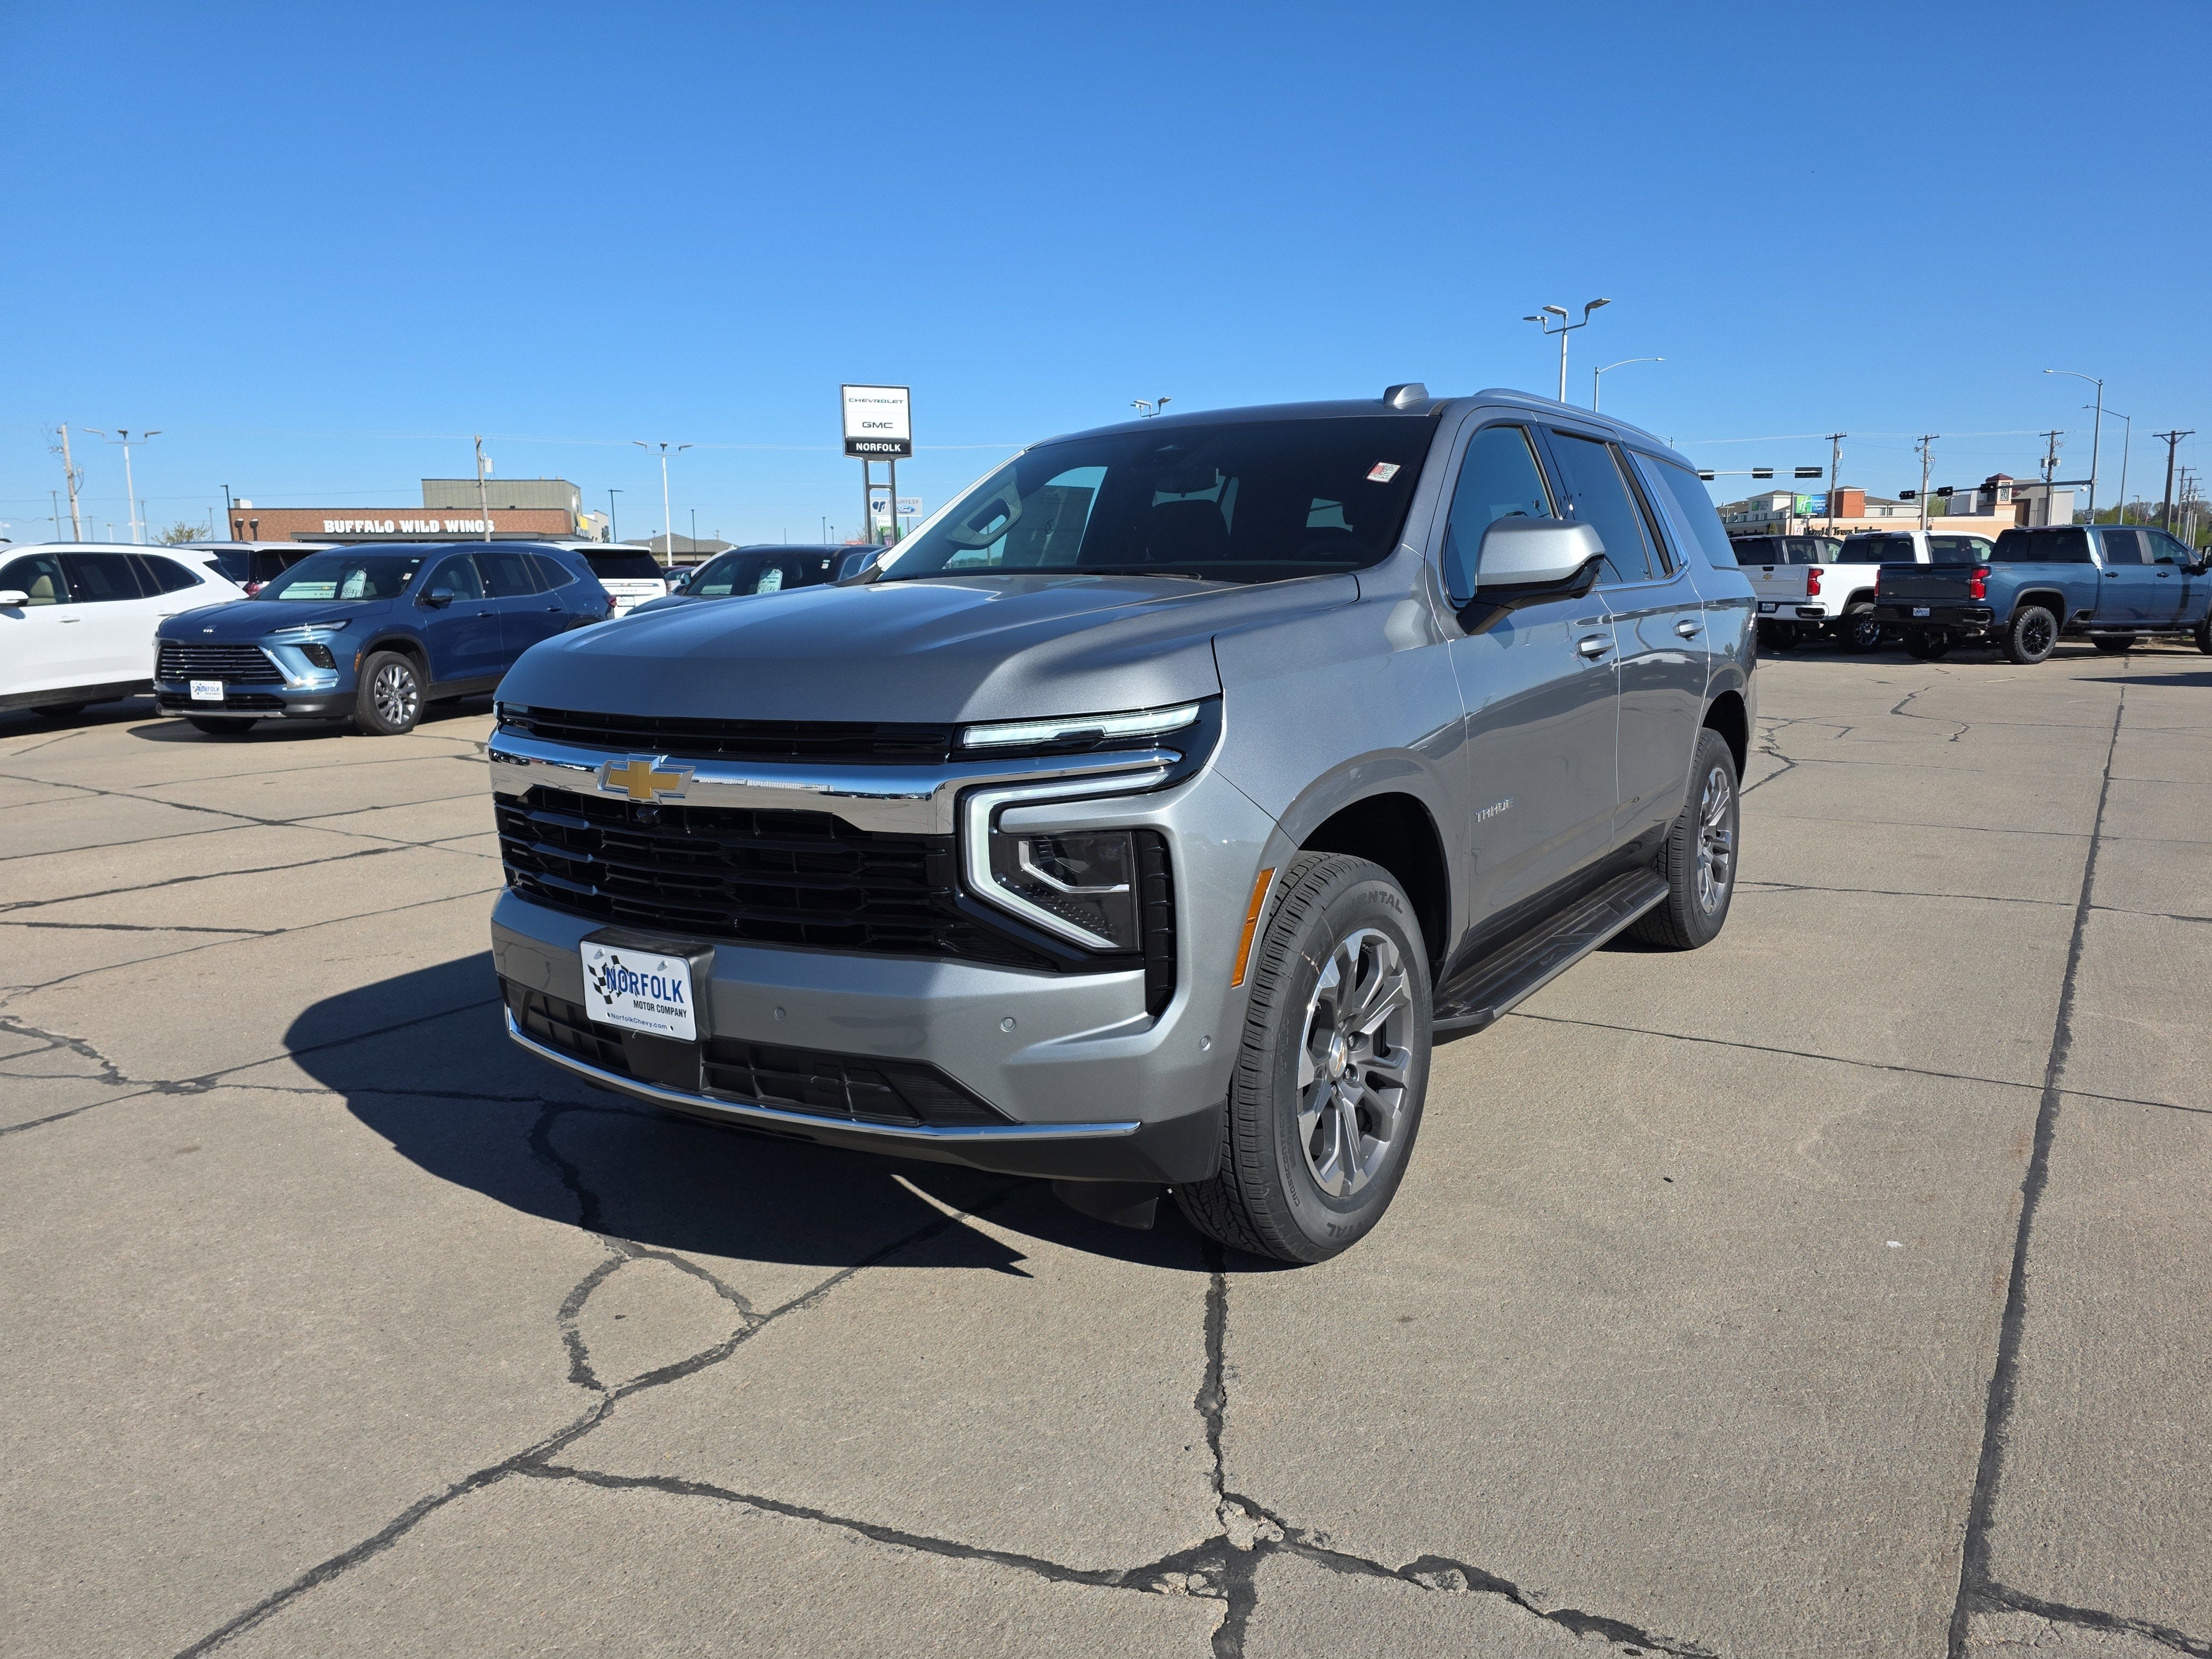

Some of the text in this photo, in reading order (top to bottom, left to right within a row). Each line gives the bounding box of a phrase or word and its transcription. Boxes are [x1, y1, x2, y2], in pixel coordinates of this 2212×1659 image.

[856, 442, 901, 452] NORFOLK
[323, 519, 494, 533] BUFFALO WILD WINGS
[606, 967, 685, 1004] NORFOLK
[633, 999, 687, 1018] MOTOR COMPANY
[611, 1012, 667, 1030] NorfolkChevy.com
